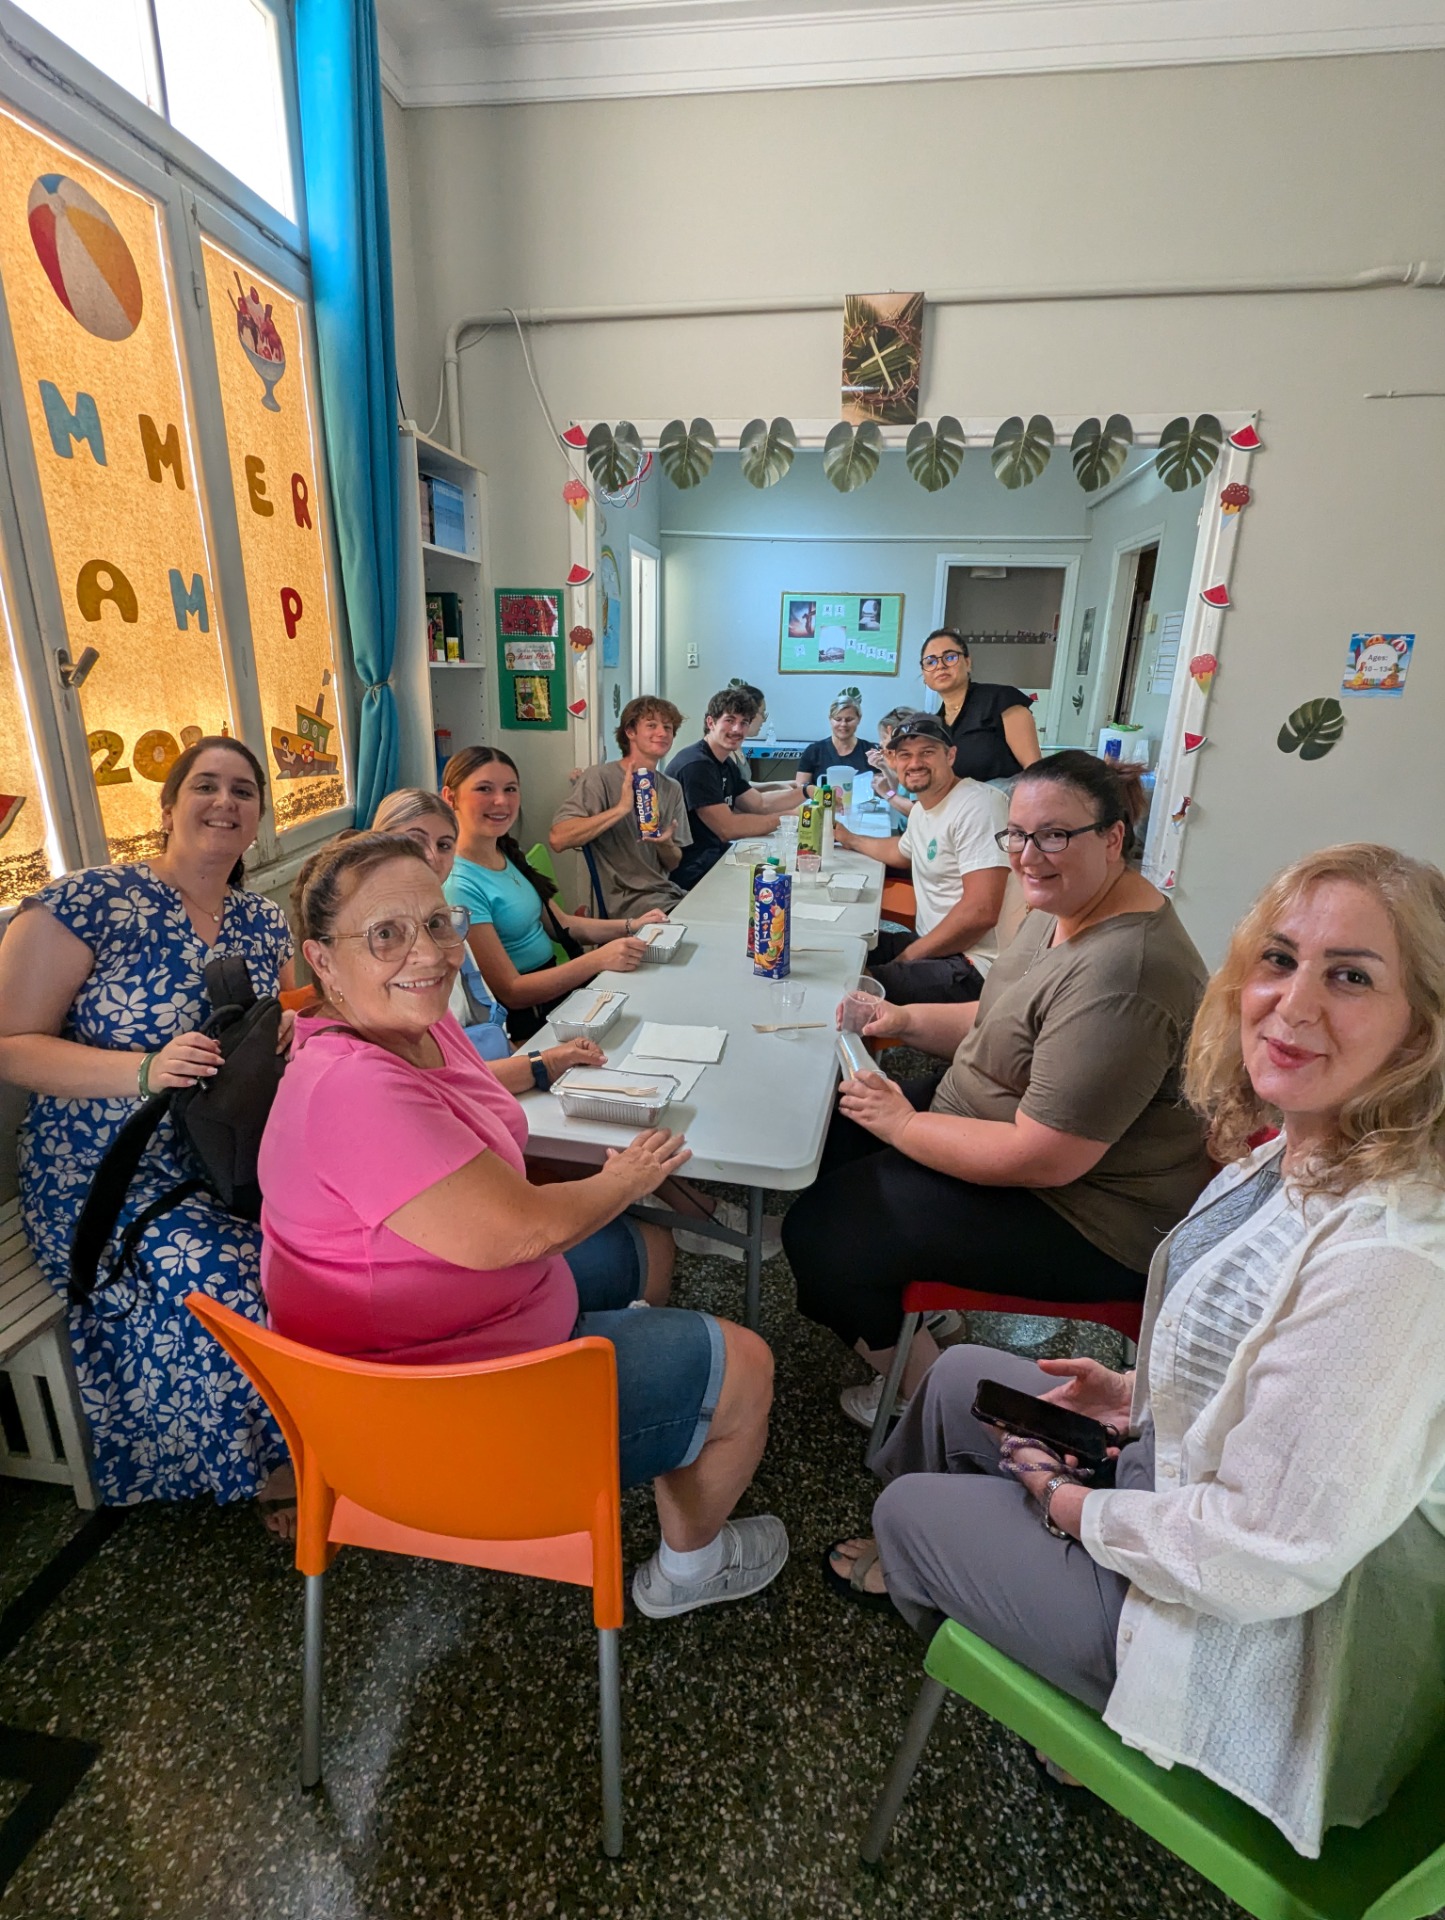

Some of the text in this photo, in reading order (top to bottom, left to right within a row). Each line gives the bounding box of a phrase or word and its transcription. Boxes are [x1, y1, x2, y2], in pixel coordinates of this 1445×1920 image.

[1368, 654, 1389, 662] Ages:
[773, 751, 803, 759] HOCKEY
[636, 789, 646, 824] motion
[762, 912, 769, 920] 9
